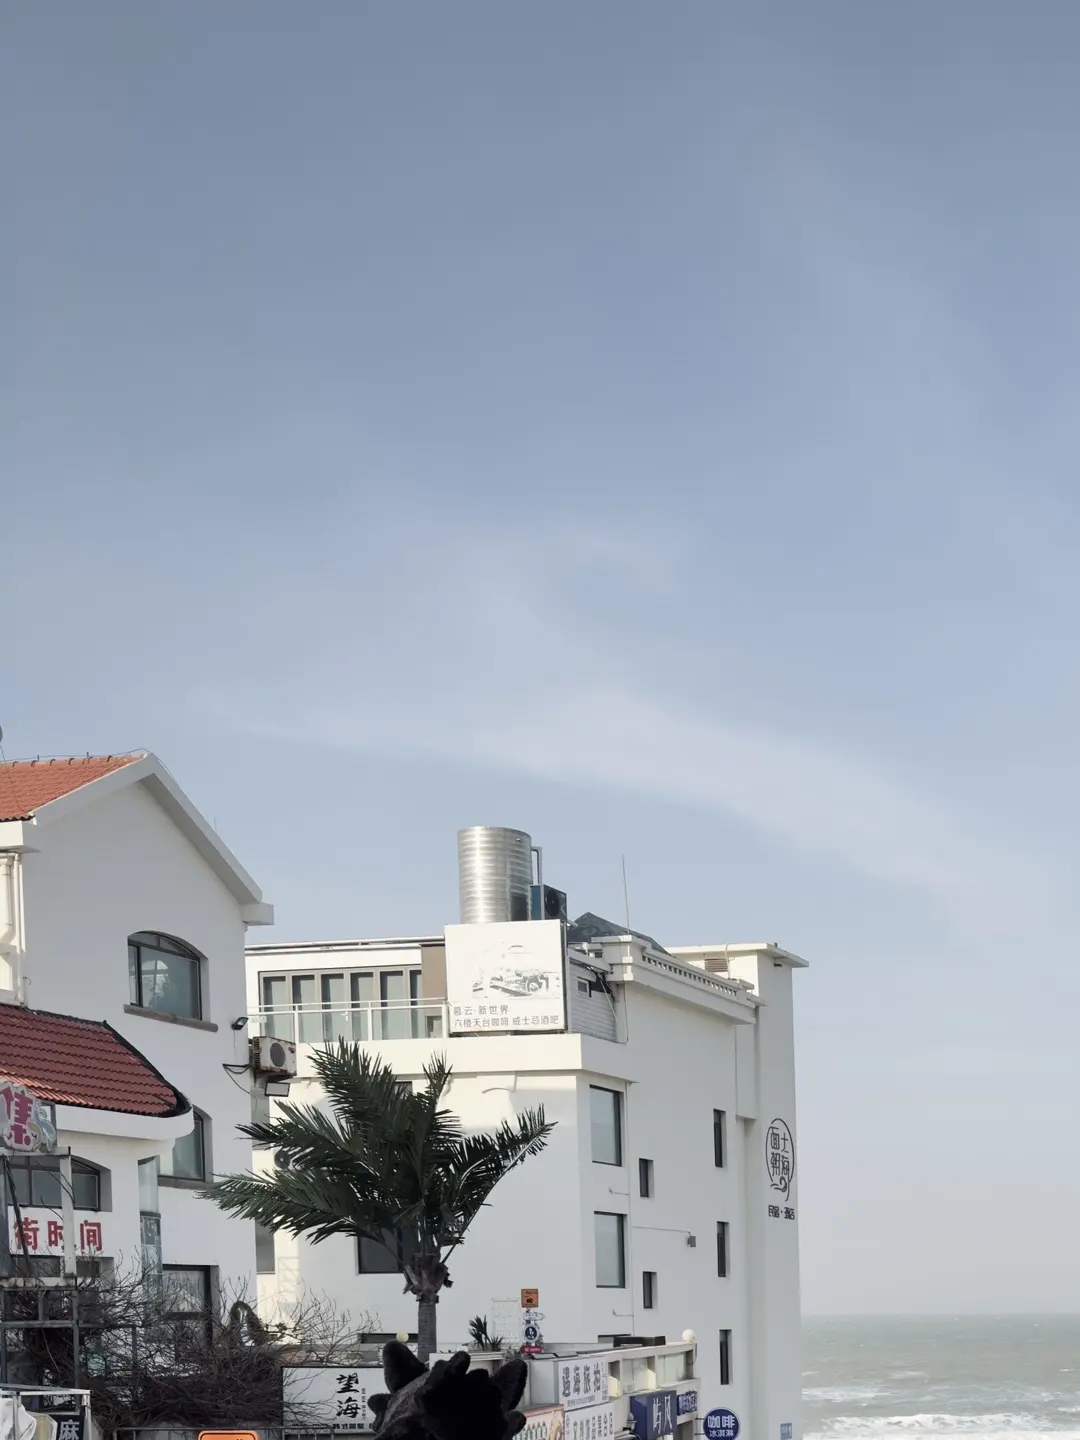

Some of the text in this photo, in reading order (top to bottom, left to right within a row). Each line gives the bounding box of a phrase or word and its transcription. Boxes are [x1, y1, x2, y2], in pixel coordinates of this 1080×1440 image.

[336, 1372, 361, 1418] 望海
[707, 1414, 735, 1428] 咖啡
[709, 1429, 734, 1438] 冰淇淋
